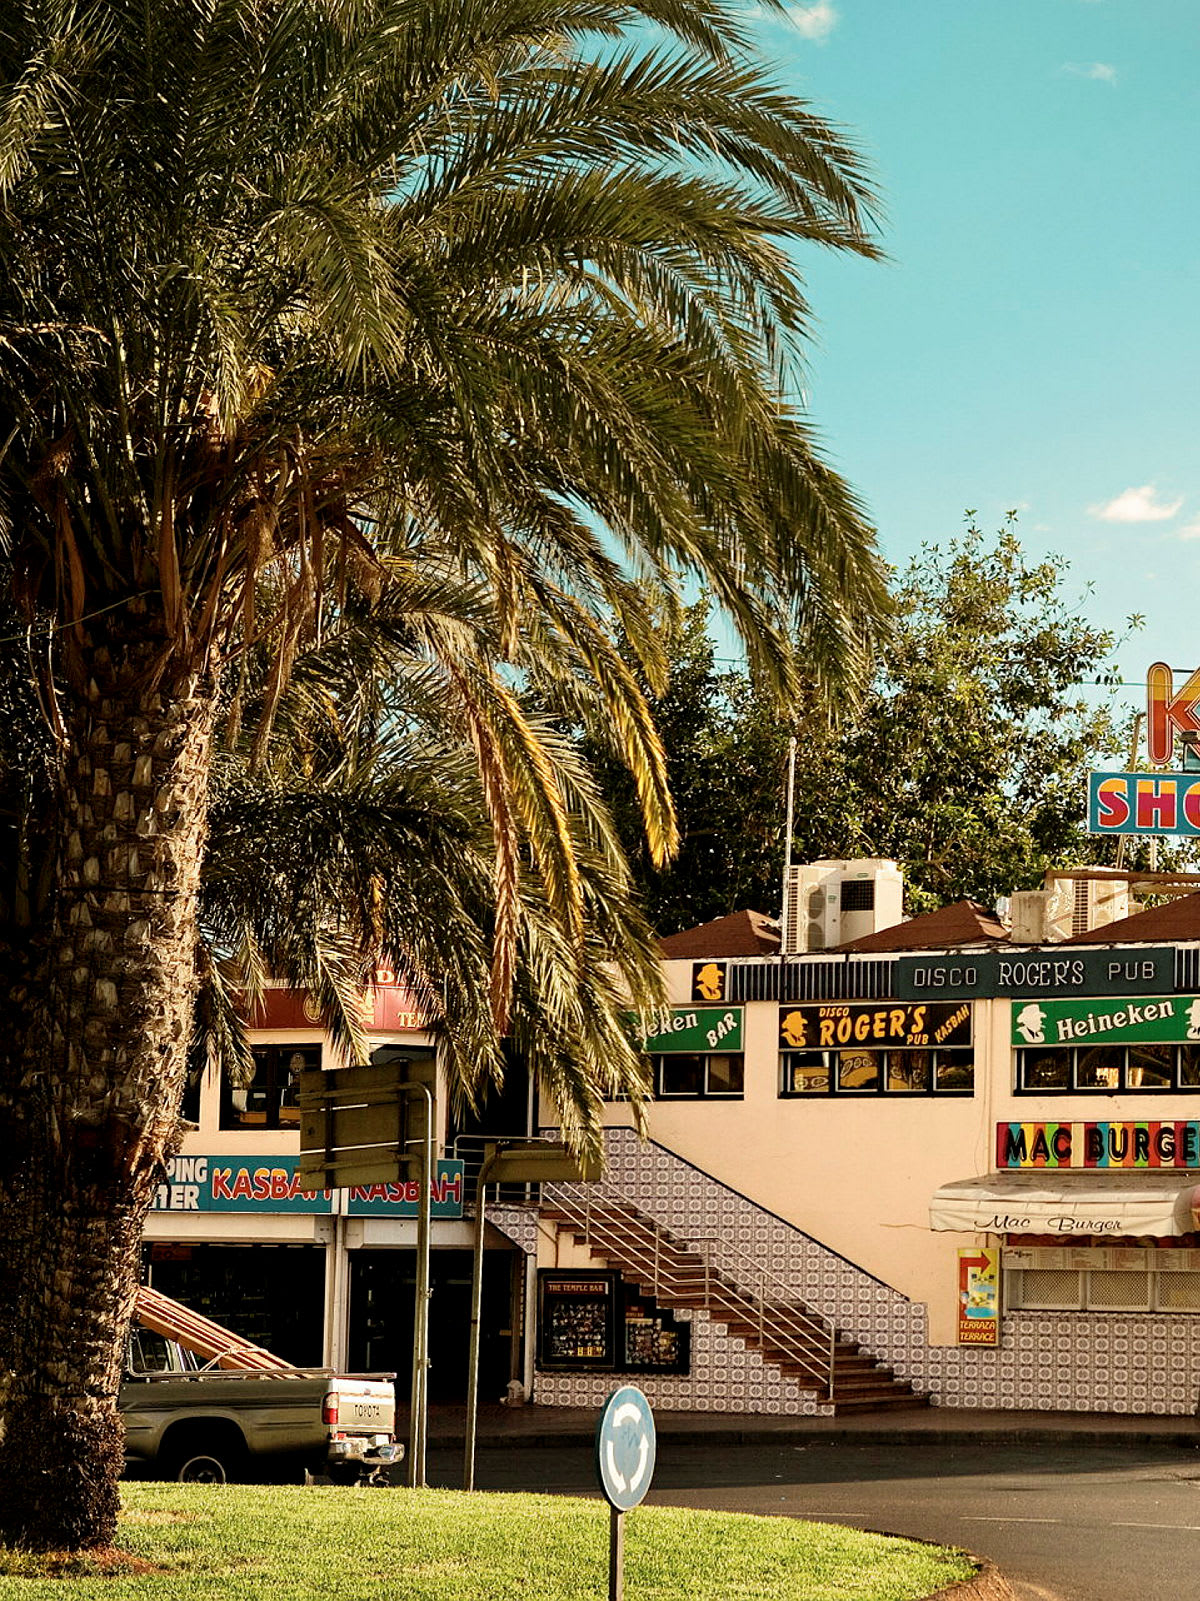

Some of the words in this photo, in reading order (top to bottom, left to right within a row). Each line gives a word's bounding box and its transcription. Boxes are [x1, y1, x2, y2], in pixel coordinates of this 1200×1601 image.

[913, 967, 977, 987] DISCO
[998, 960, 1085, 986] ROGER'S
[1108, 961, 1154, 980] PUB
[819, 1006, 850, 1019] DISCO
[1056, 1001, 1174, 1042] Heineken
[706, 1013, 738, 1048] BAR
[820, 1005, 926, 1046] ROGER'S
[934, 1003, 971, 1043] KASBAH
[906, 1033, 929, 1046] PUB
[1004, 1127, 1073, 1162] MAC
[974, 1214, 1031, 1229] Mac
[1047, 1216, 1122, 1232] Burger
[563, 1284, 588, 1292] TEMPLE
[589, 1284, 604, 1292] BAR
[959, 1320, 996, 1330] TERRAZA
[959, 1332, 995, 1341] TERRACE
[354, 1404, 380, 1418] TOYOTA
